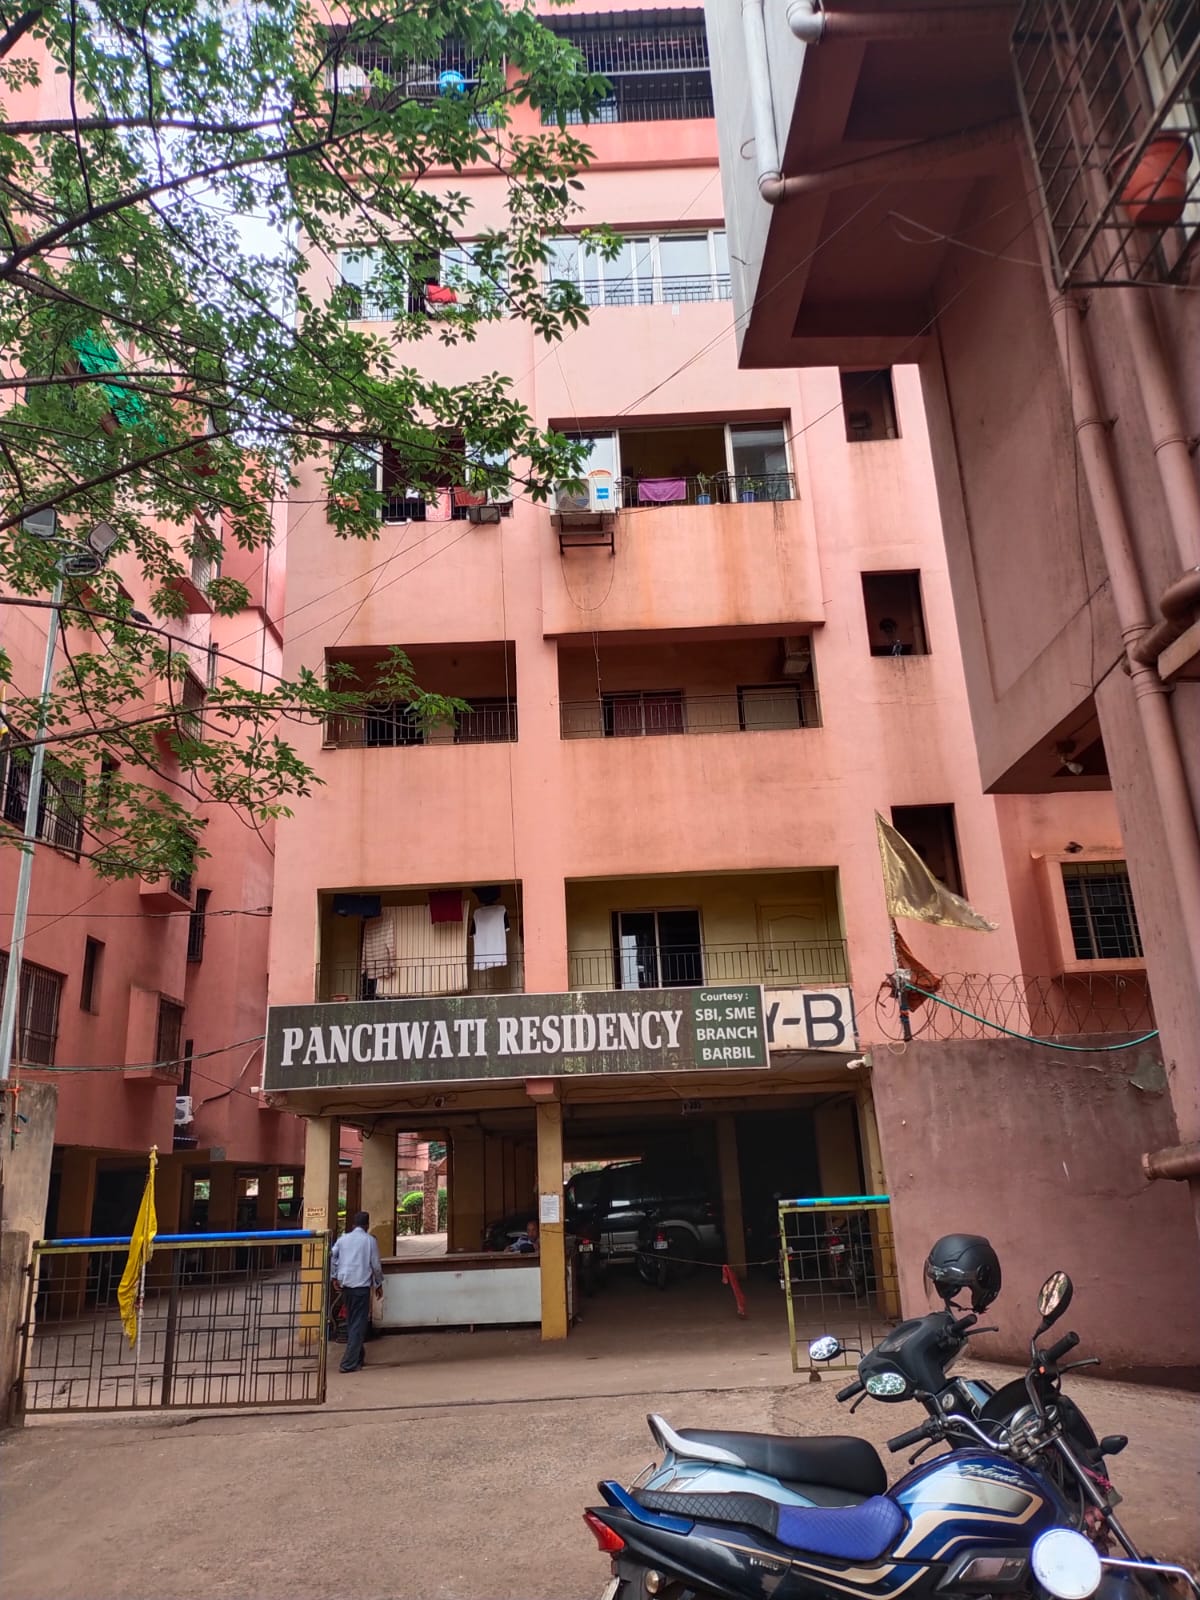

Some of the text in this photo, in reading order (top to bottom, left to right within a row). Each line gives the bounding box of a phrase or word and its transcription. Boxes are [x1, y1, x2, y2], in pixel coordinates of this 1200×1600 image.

[700, 992, 743, 1002] Courtesy
[695, 1007, 756, 1022] SBI, SME
[280, 1010, 684, 1067] PANCHWATI RESIDENCY
[696, 1027, 758, 1041] BRANCH
[702, 1047, 756, 1061] BARBIL
